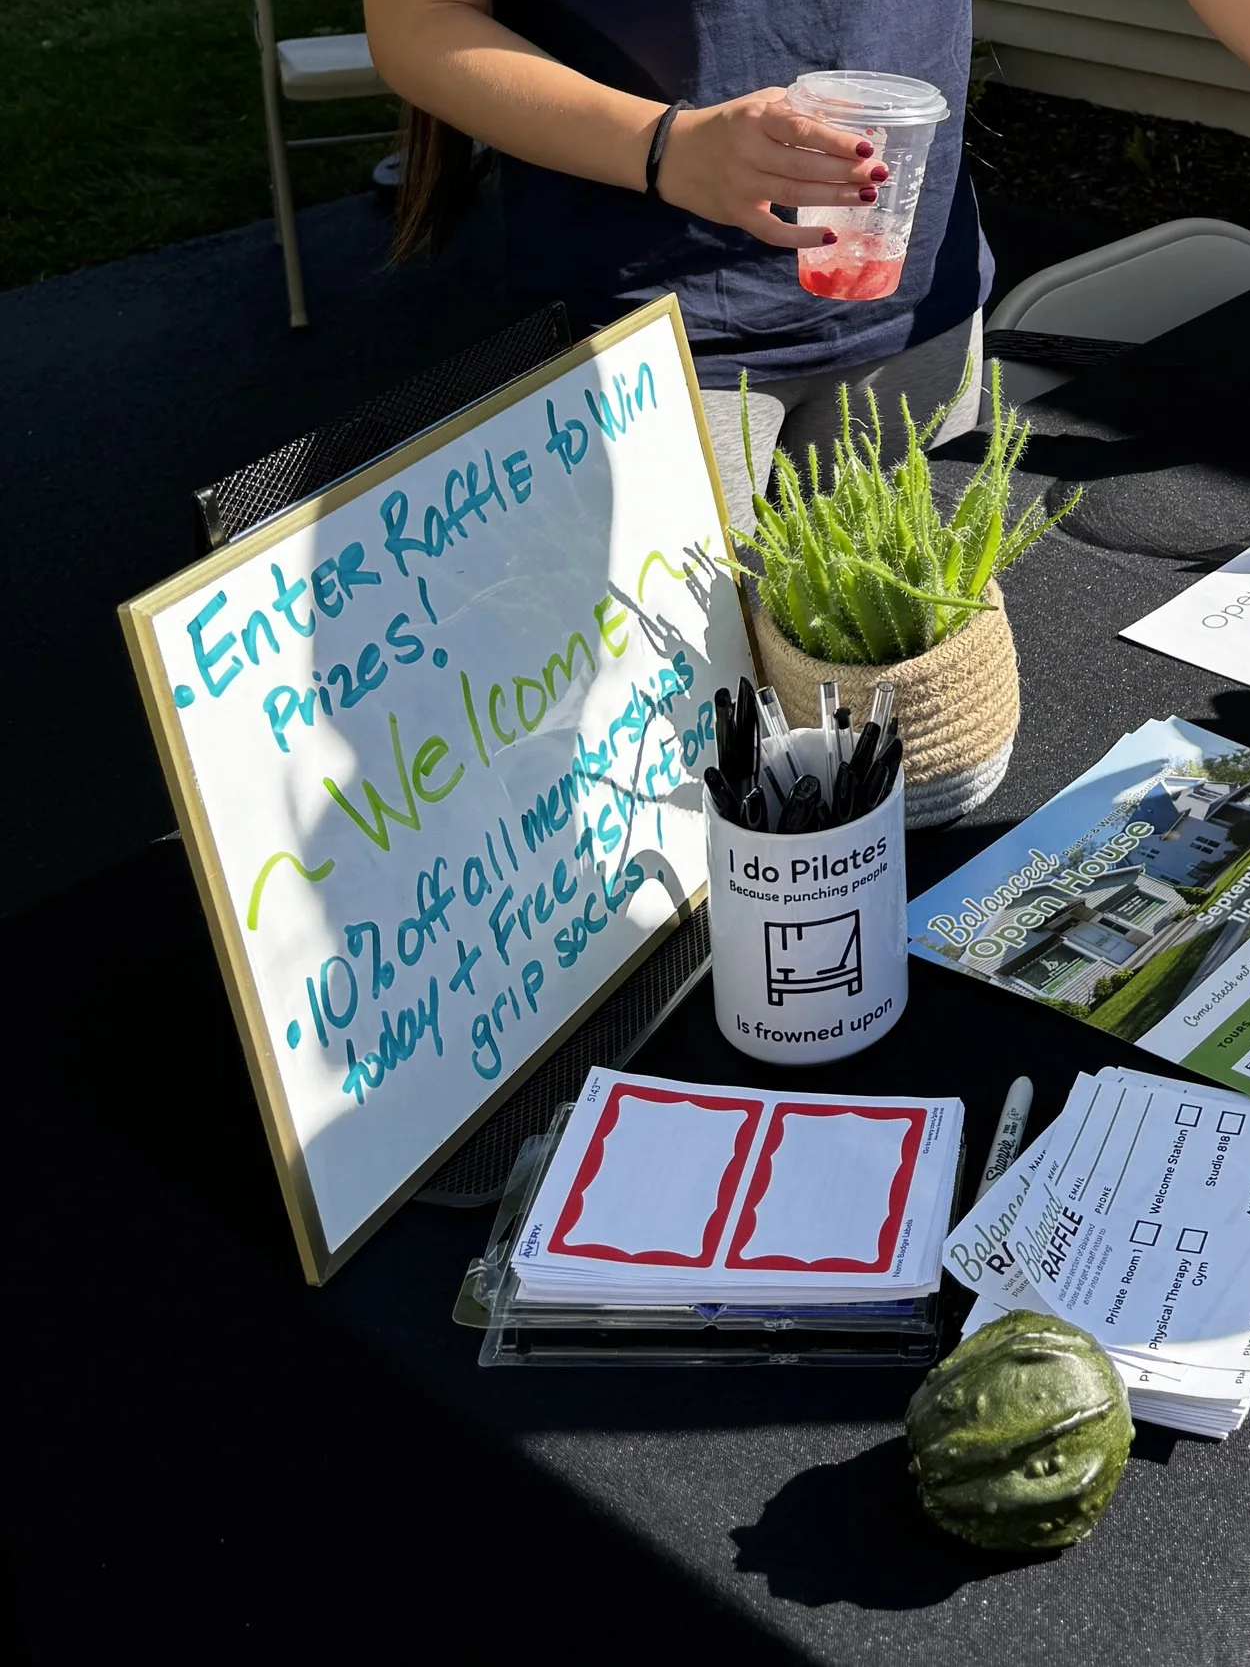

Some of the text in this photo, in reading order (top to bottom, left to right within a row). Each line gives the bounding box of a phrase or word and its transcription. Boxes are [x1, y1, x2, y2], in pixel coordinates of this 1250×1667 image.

[546, 398, 588, 475] to
[585, 361, 657, 441] Win
[306, 650, 694, 1048] 10% off all memberships
[728, 835, 887, 884] I do Pilates
[729, 860, 889, 906] Because punching people
[927, 848, 1060, 947] Balanced
[966, 821, 1155, 960] Open House
[342, 975, 443, 1105] today
[449, 939, 482, 995] +
[489, 858, 578, 966] Free
[1183, 1002, 1214, 1027] Come
[1212, 979, 1238, 1004] check
[472, 959, 544, 1080] grip
[736, 996, 893, 1044] Is frowned upon
[586, 1085, 601, 1103] 5143
[1048, 1161, 1060, 1182] NAME
[1068, 1176, 1085, 1201] EMAIL
[1149, 1128, 1188, 1215] Welcome Station
[1205, 1135, 1231, 1187] Studio 818
[1095, 1186, 1112, 1214] PHONE
[523, 1224, 543, 1259] AVERY
[892, 1219, 914, 1278] Name Badge Labels
[1016, 1183, 1064, 1284] Balanced
[1040, 1206, 1084, 1283] RAFFLE
[1105, 1287, 1128, 1325] Private
[1121, 1256, 1142, 1285] Room
[1192, 1261, 1209, 1287] Gym
[1149, 1258, 1192, 1351] Physical Therapy
